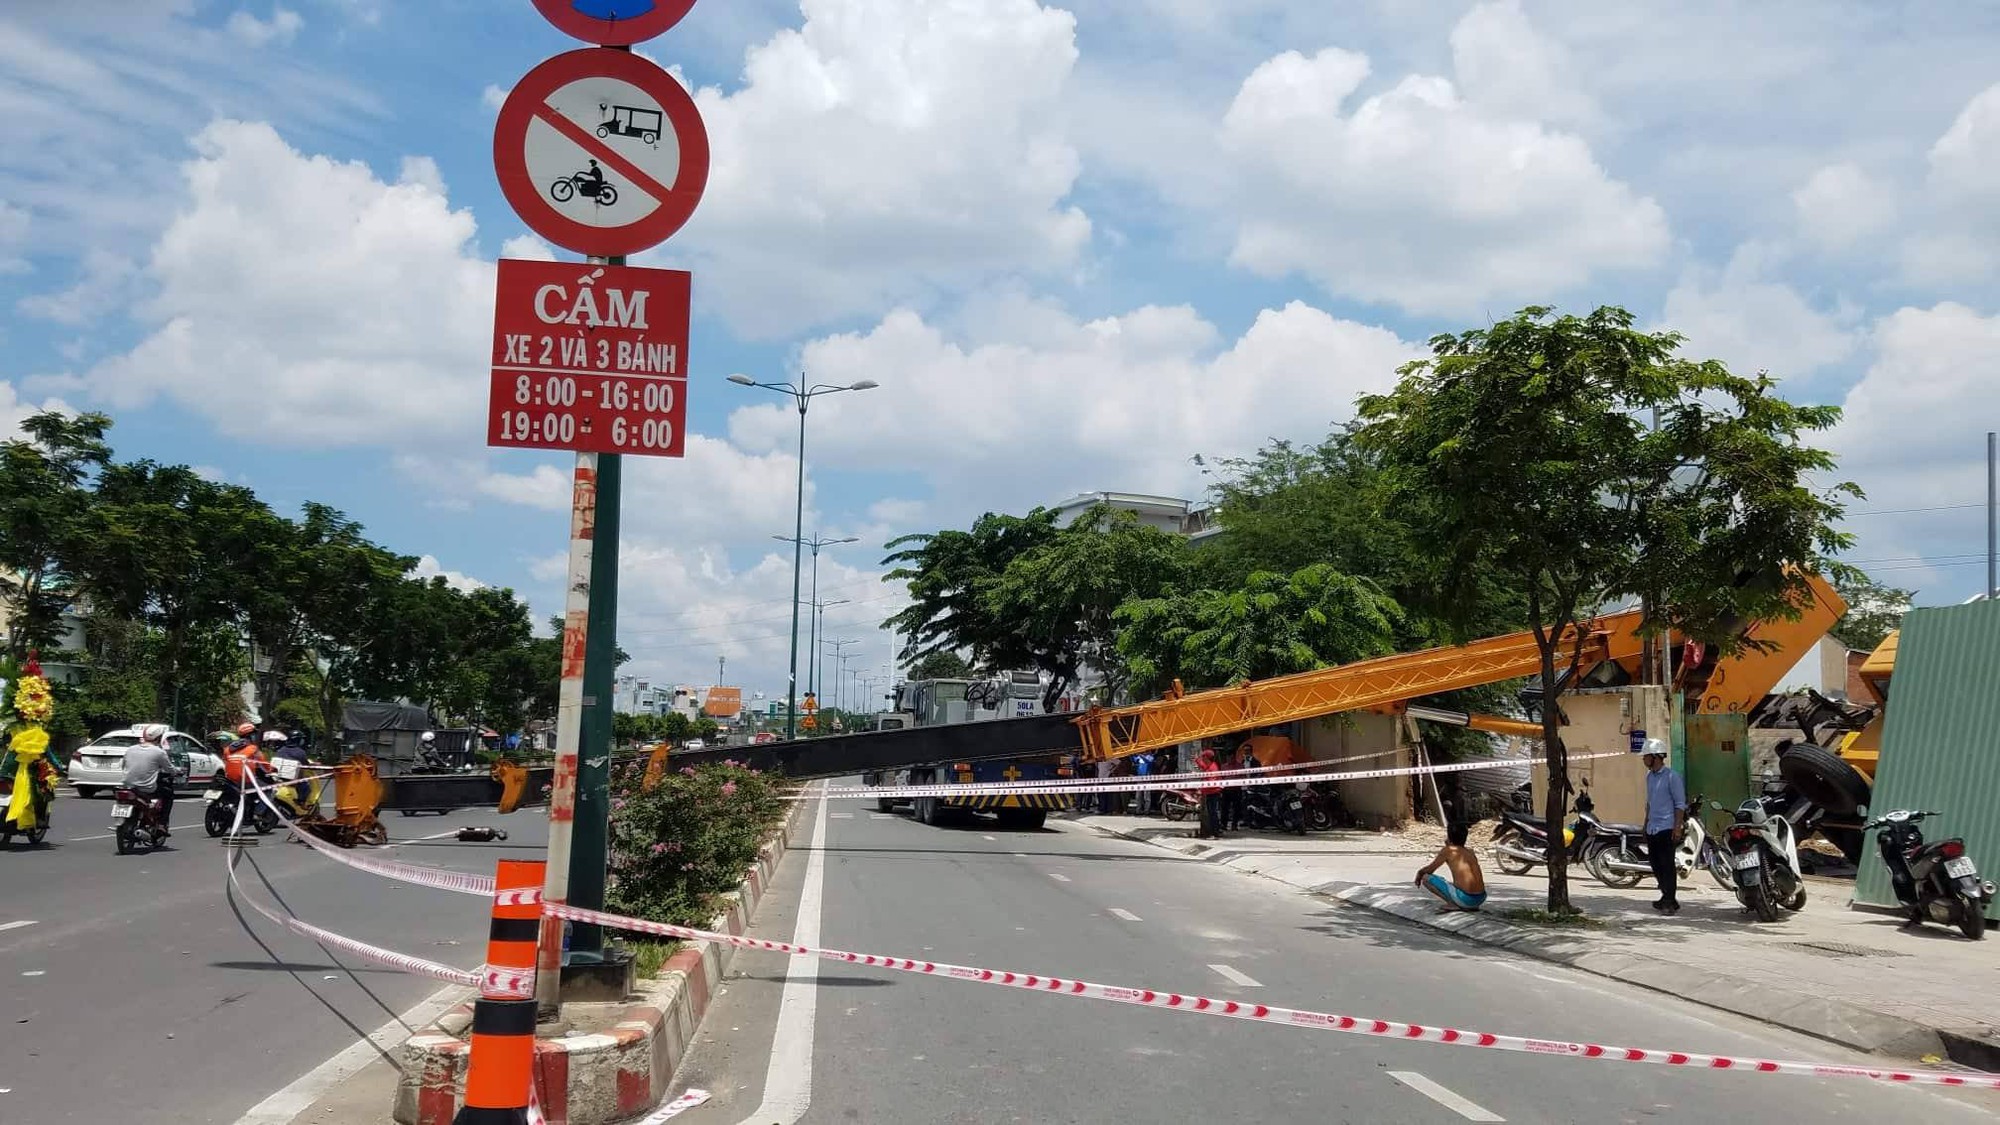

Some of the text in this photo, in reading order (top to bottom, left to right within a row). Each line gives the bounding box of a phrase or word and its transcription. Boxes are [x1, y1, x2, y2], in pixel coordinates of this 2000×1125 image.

[533, 268, 650, 330] CẤM
[503, 330, 677, 374] XE 2 VÀ 3 BÁNH
[500, 410, 575, 443] 19:00
[612, 416, 673, 449] 6:00
